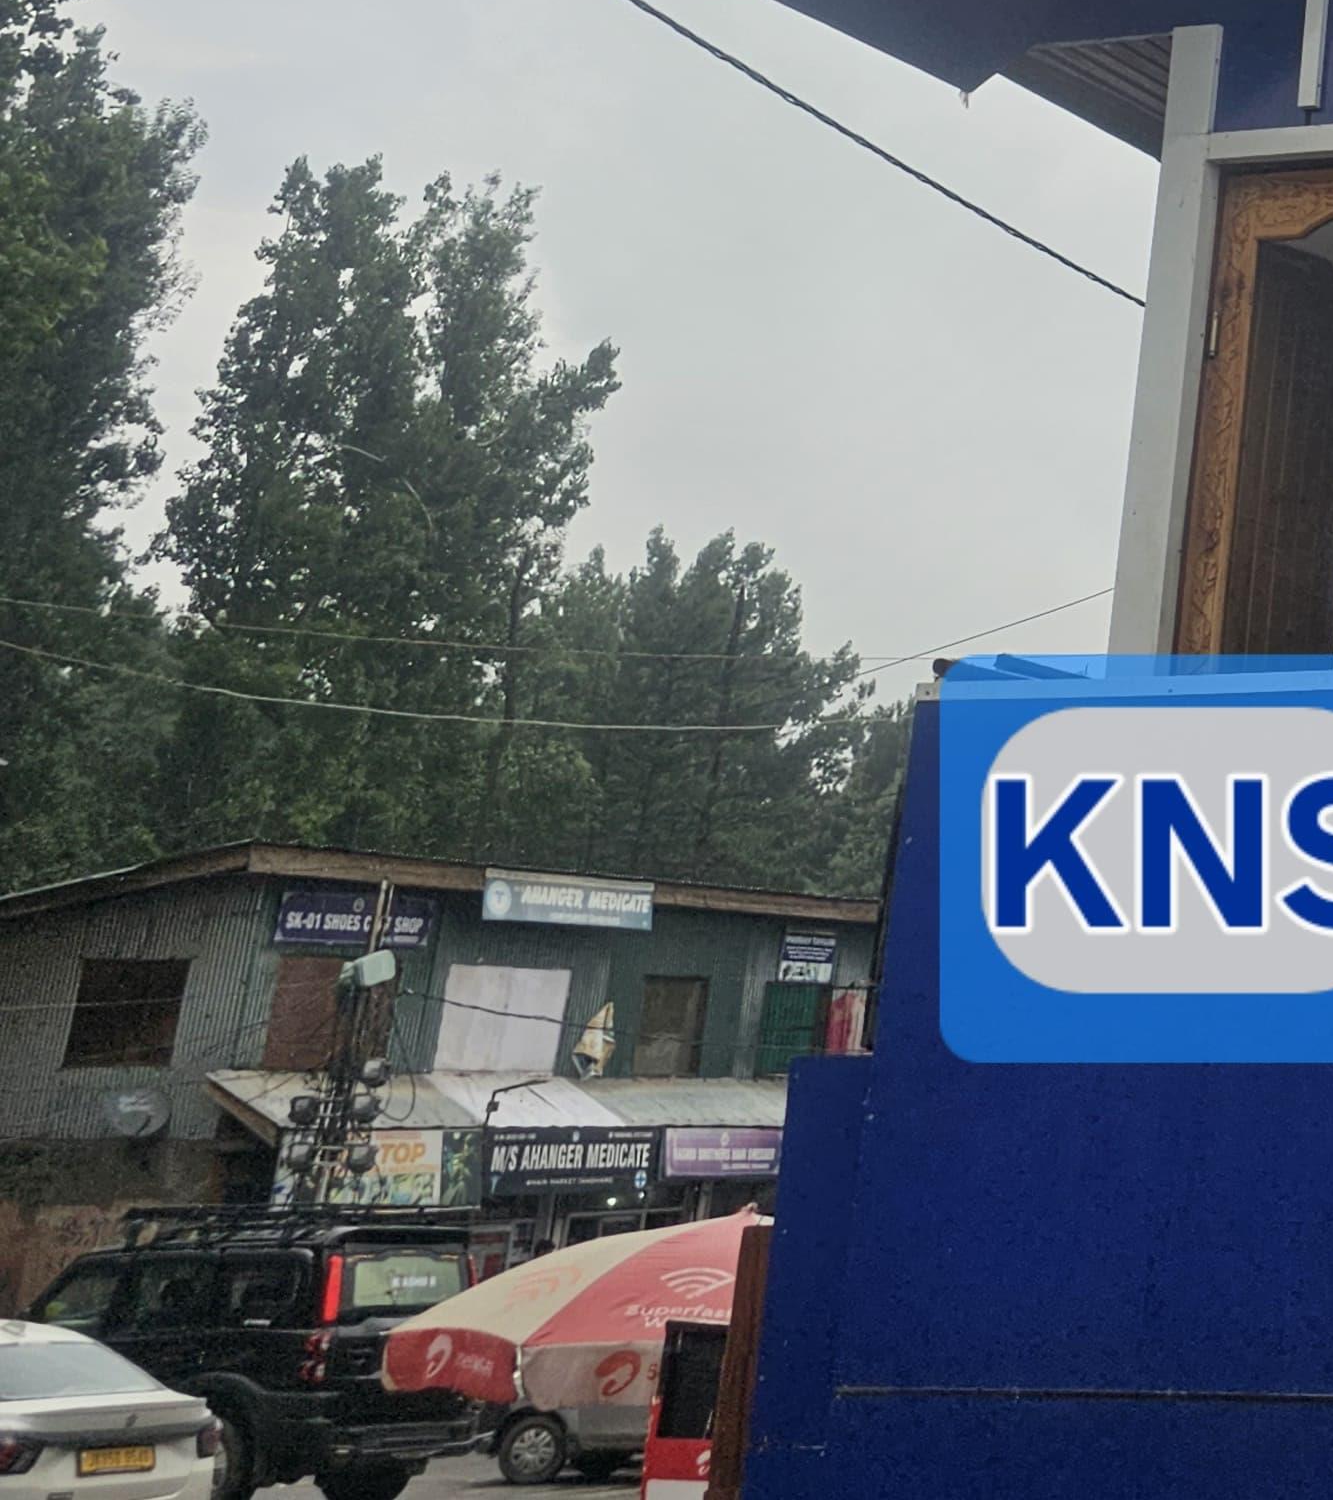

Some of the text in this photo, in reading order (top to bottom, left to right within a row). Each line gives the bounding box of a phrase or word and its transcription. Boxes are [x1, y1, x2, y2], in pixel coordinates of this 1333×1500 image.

[323, 913, 362, 932] SHOES
[394, 916, 424, 934] SHOP
[379, 1142, 427, 1164] TOP
[490, 1144, 520, 1173] M/S
[520, 1143, 584, 1171] AHANGER
[586, 1142, 651, 1169] MEDICATE
